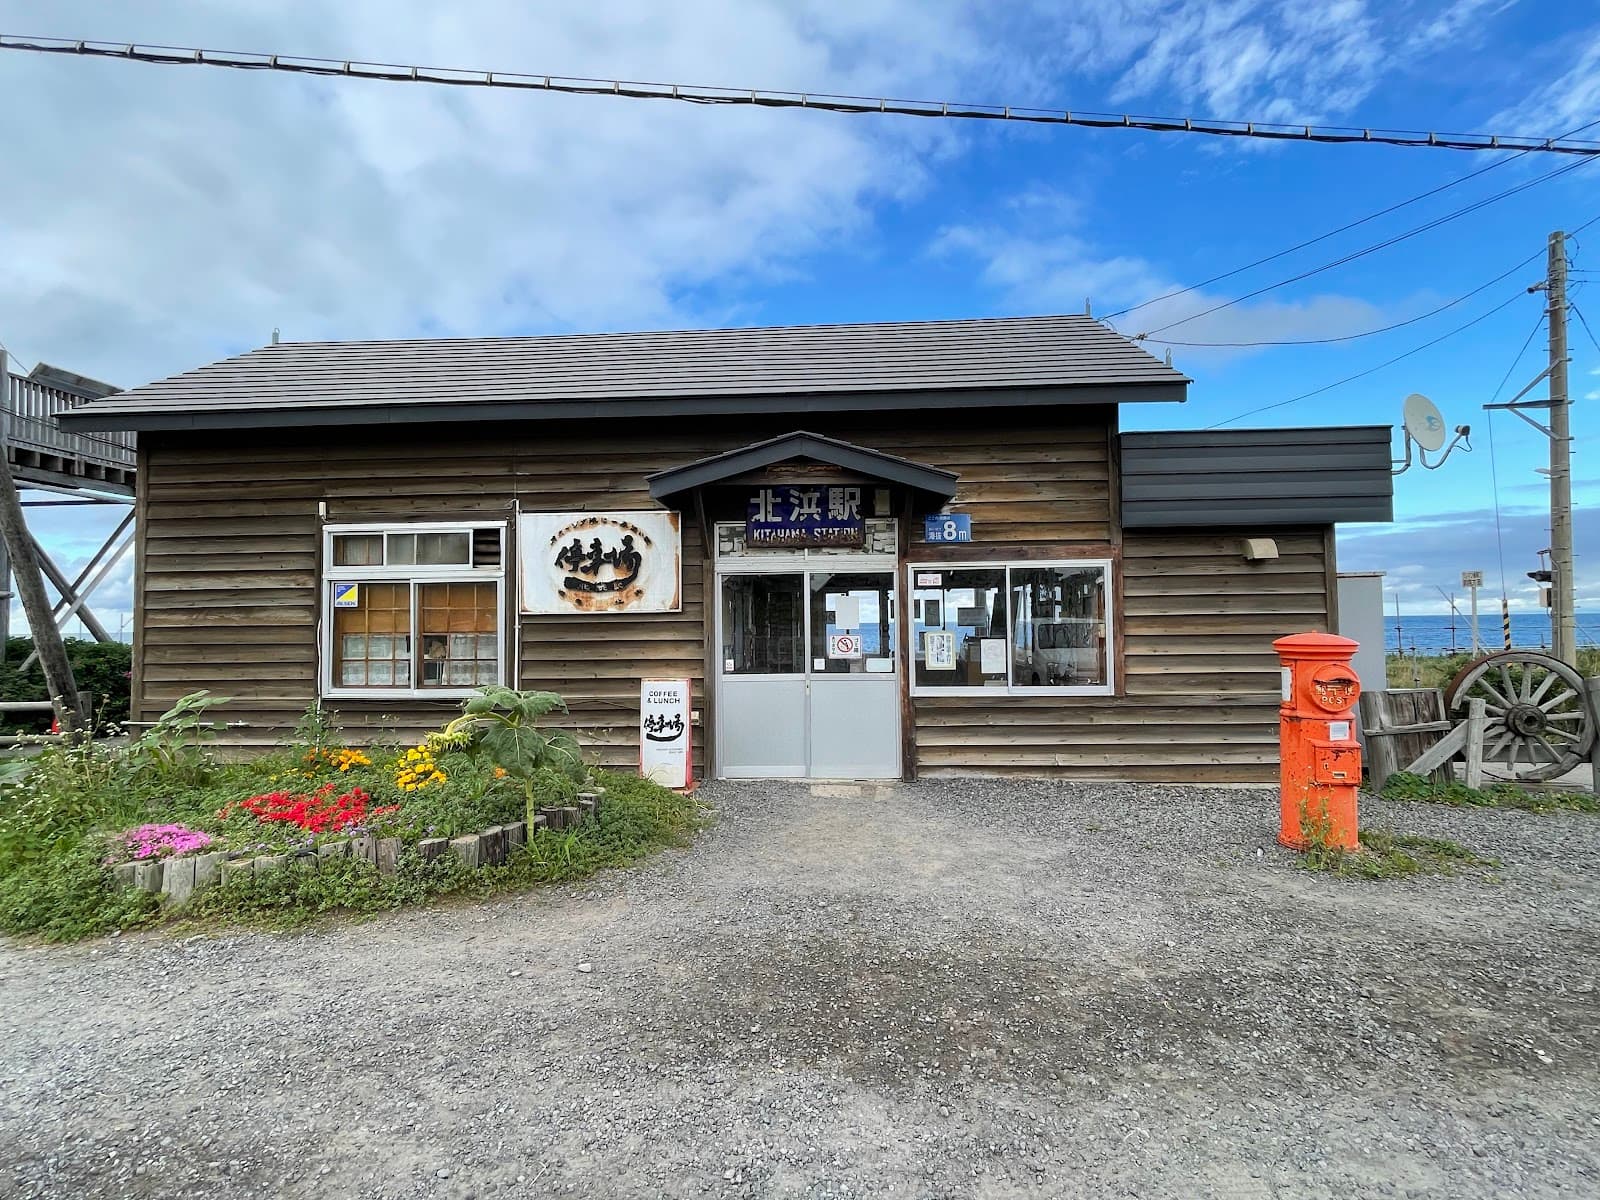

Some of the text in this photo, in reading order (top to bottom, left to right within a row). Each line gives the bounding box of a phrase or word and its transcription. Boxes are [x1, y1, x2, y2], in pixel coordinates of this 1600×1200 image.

[750, 487, 861, 522] 北浜駅
[753, 528, 807, 541] KITAHAMA
